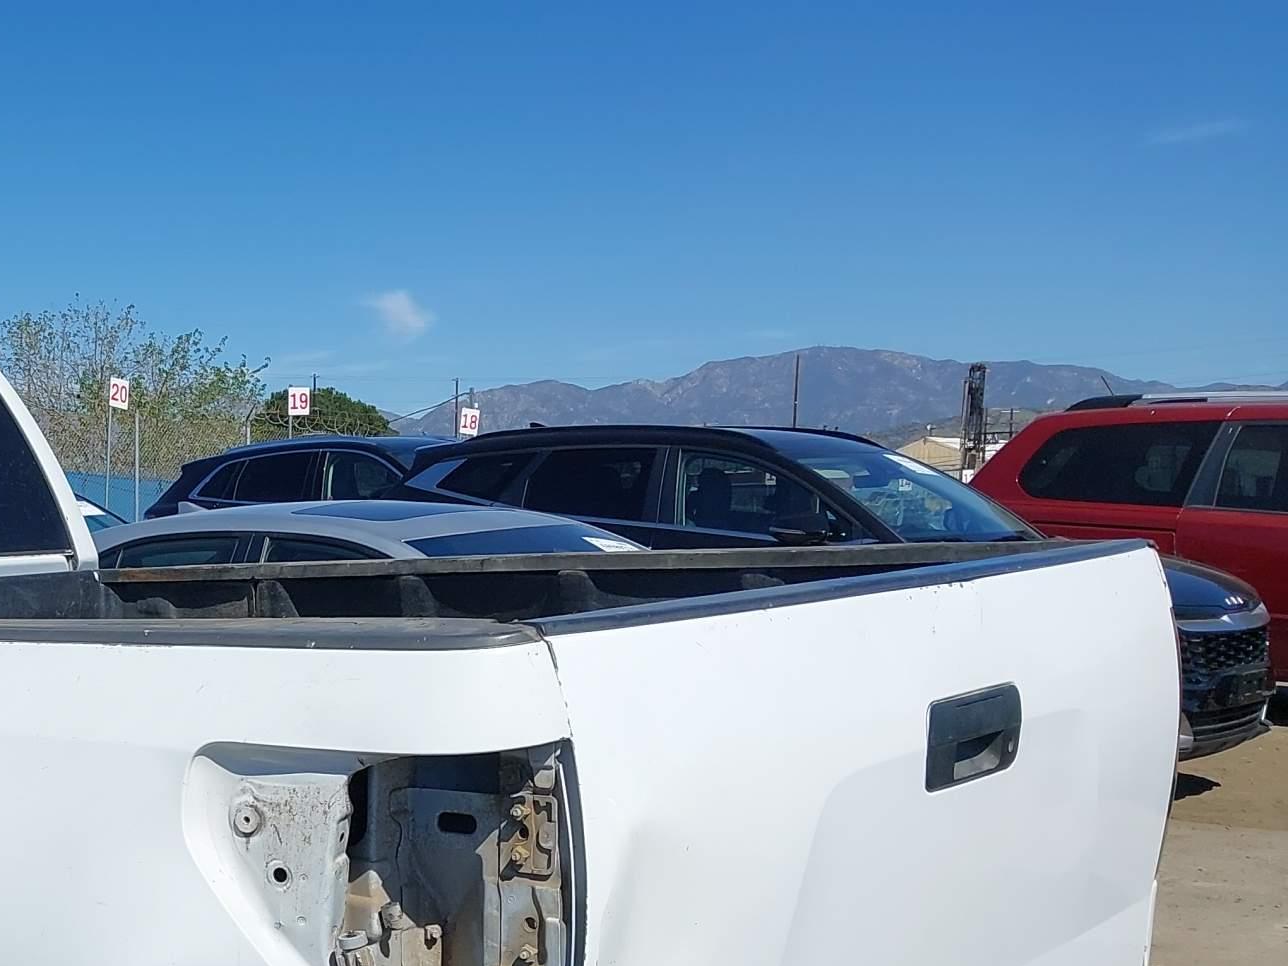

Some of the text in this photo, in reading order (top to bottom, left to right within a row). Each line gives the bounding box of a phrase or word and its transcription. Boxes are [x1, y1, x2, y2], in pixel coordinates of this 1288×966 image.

[111, 383, 128, 404] 20
[290, 392, 308, 410] 19
[461, 413, 477, 430] 18
